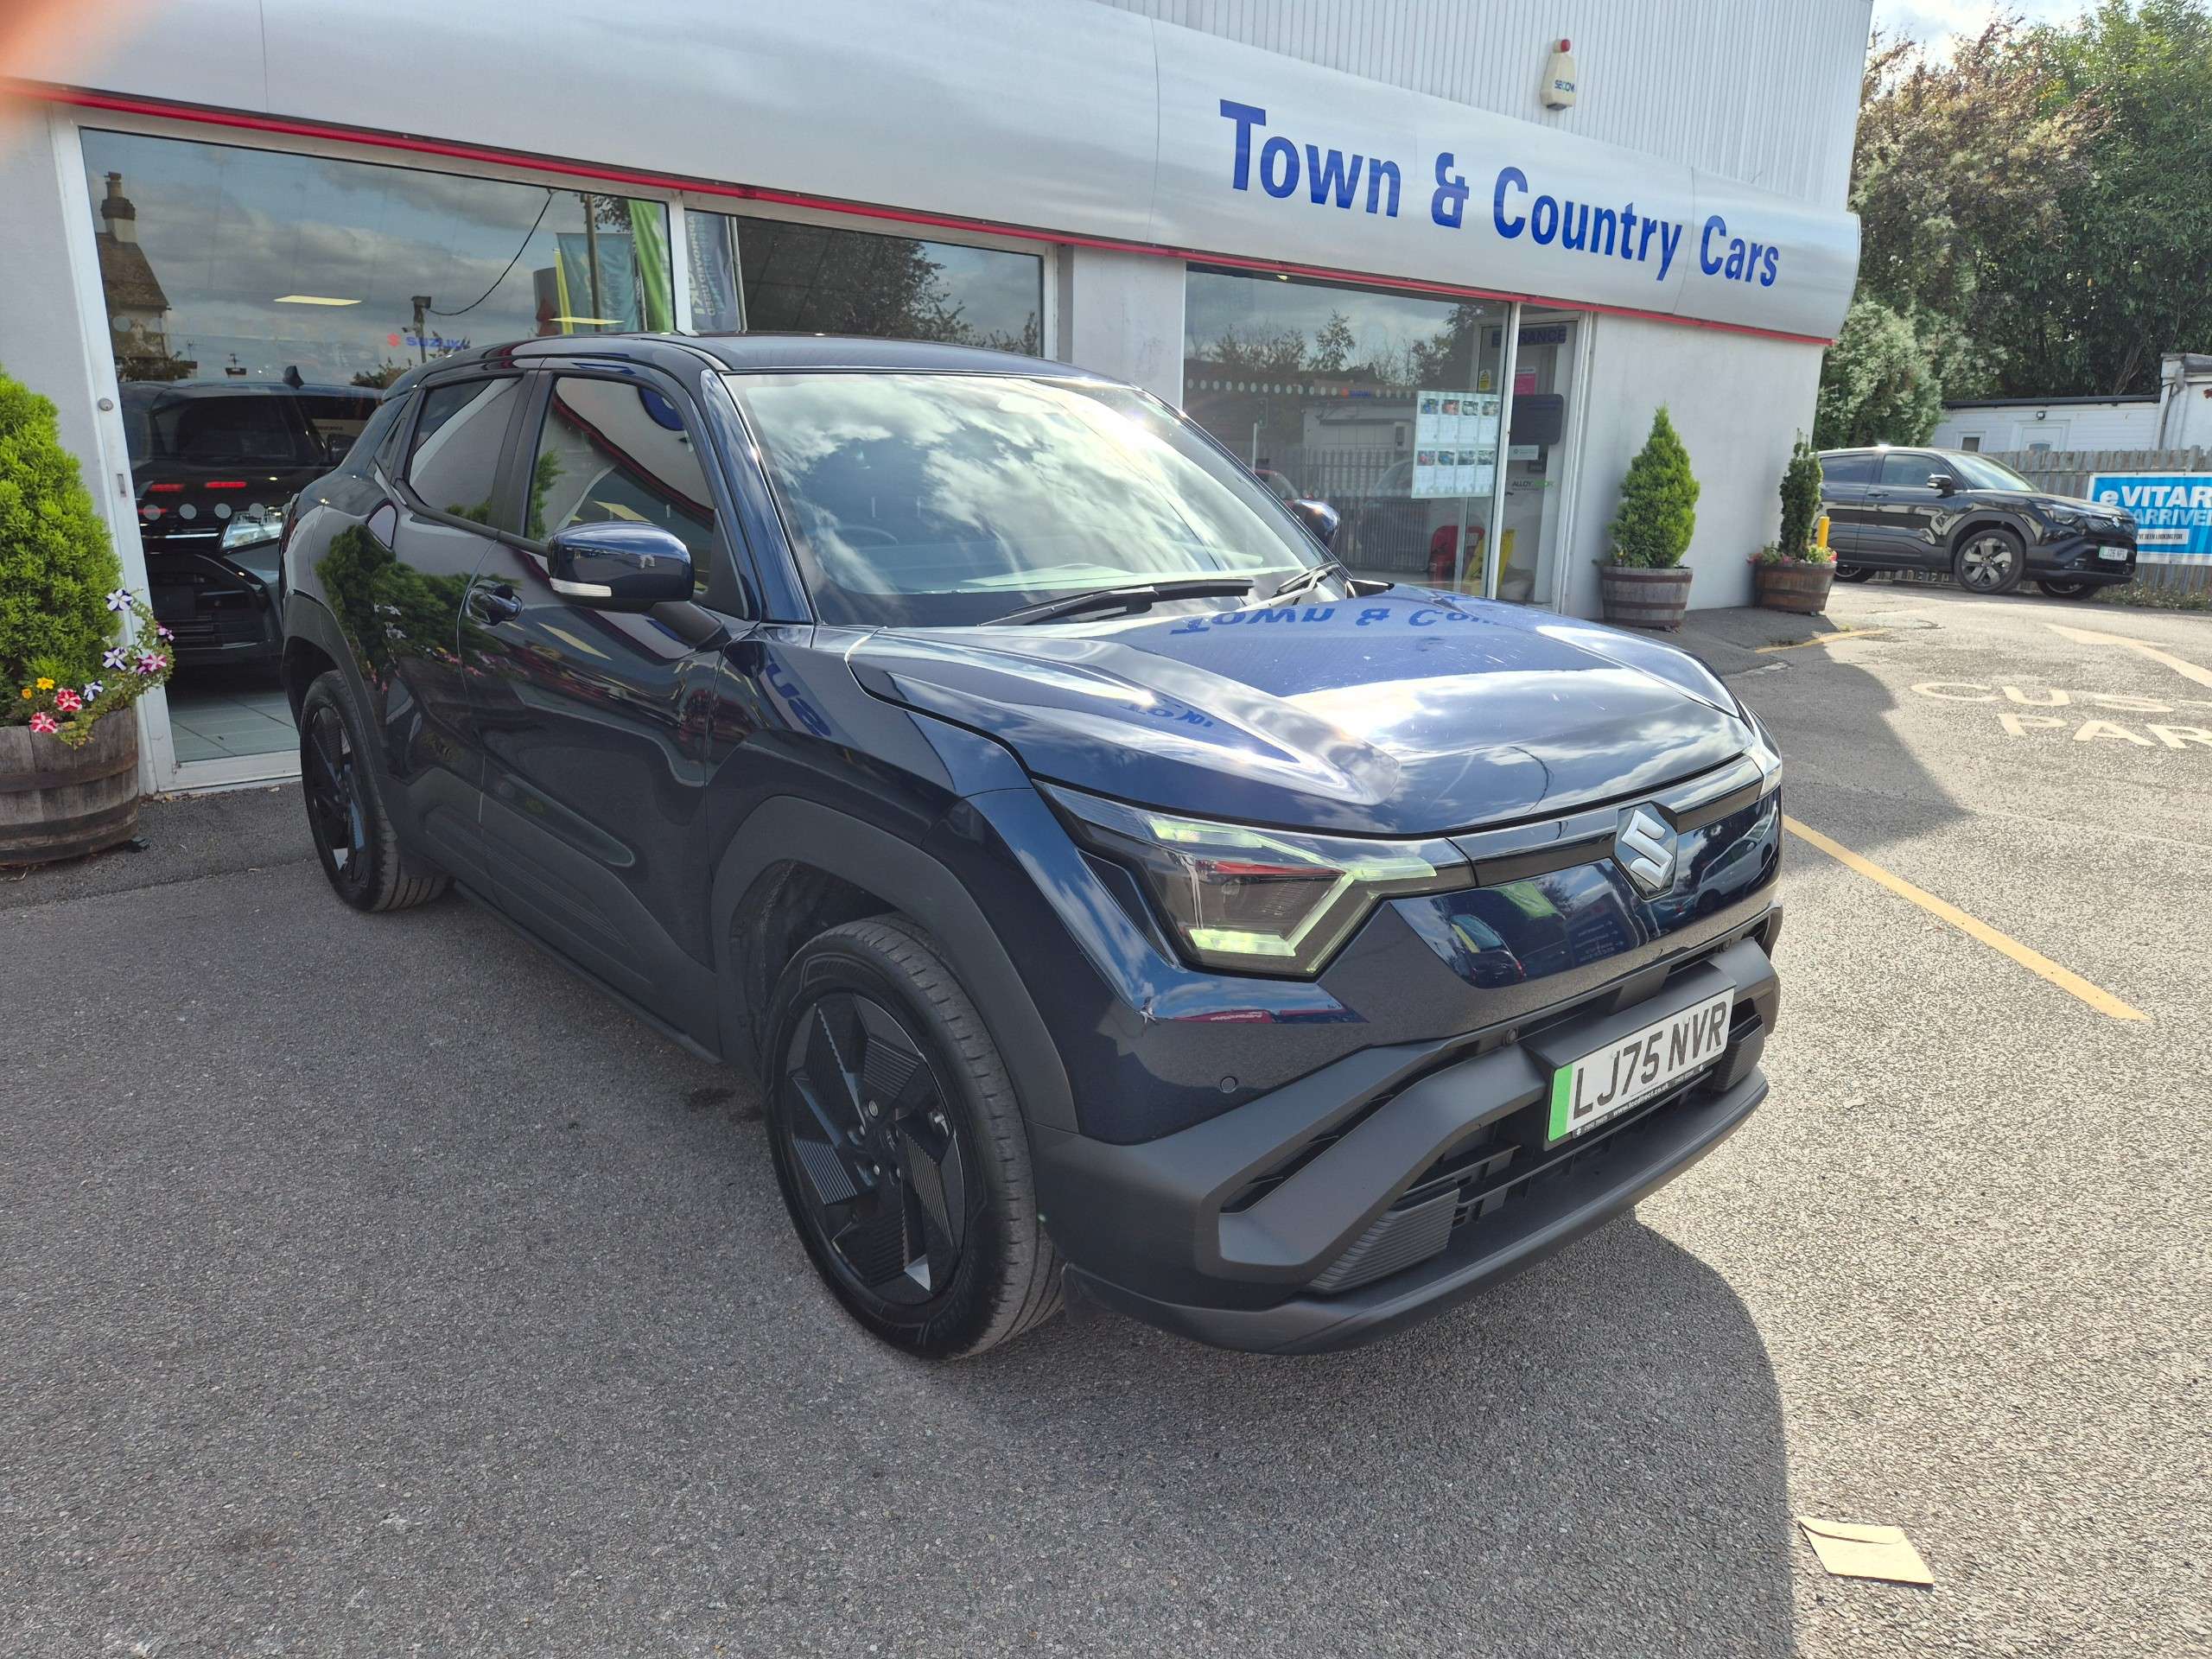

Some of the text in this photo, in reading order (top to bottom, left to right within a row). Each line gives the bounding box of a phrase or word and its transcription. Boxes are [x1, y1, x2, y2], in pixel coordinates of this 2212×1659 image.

[1220, 99, 1780, 287] Town & Country Cars
[1573, 1001, 1727, 1121] LJ75 NVR
